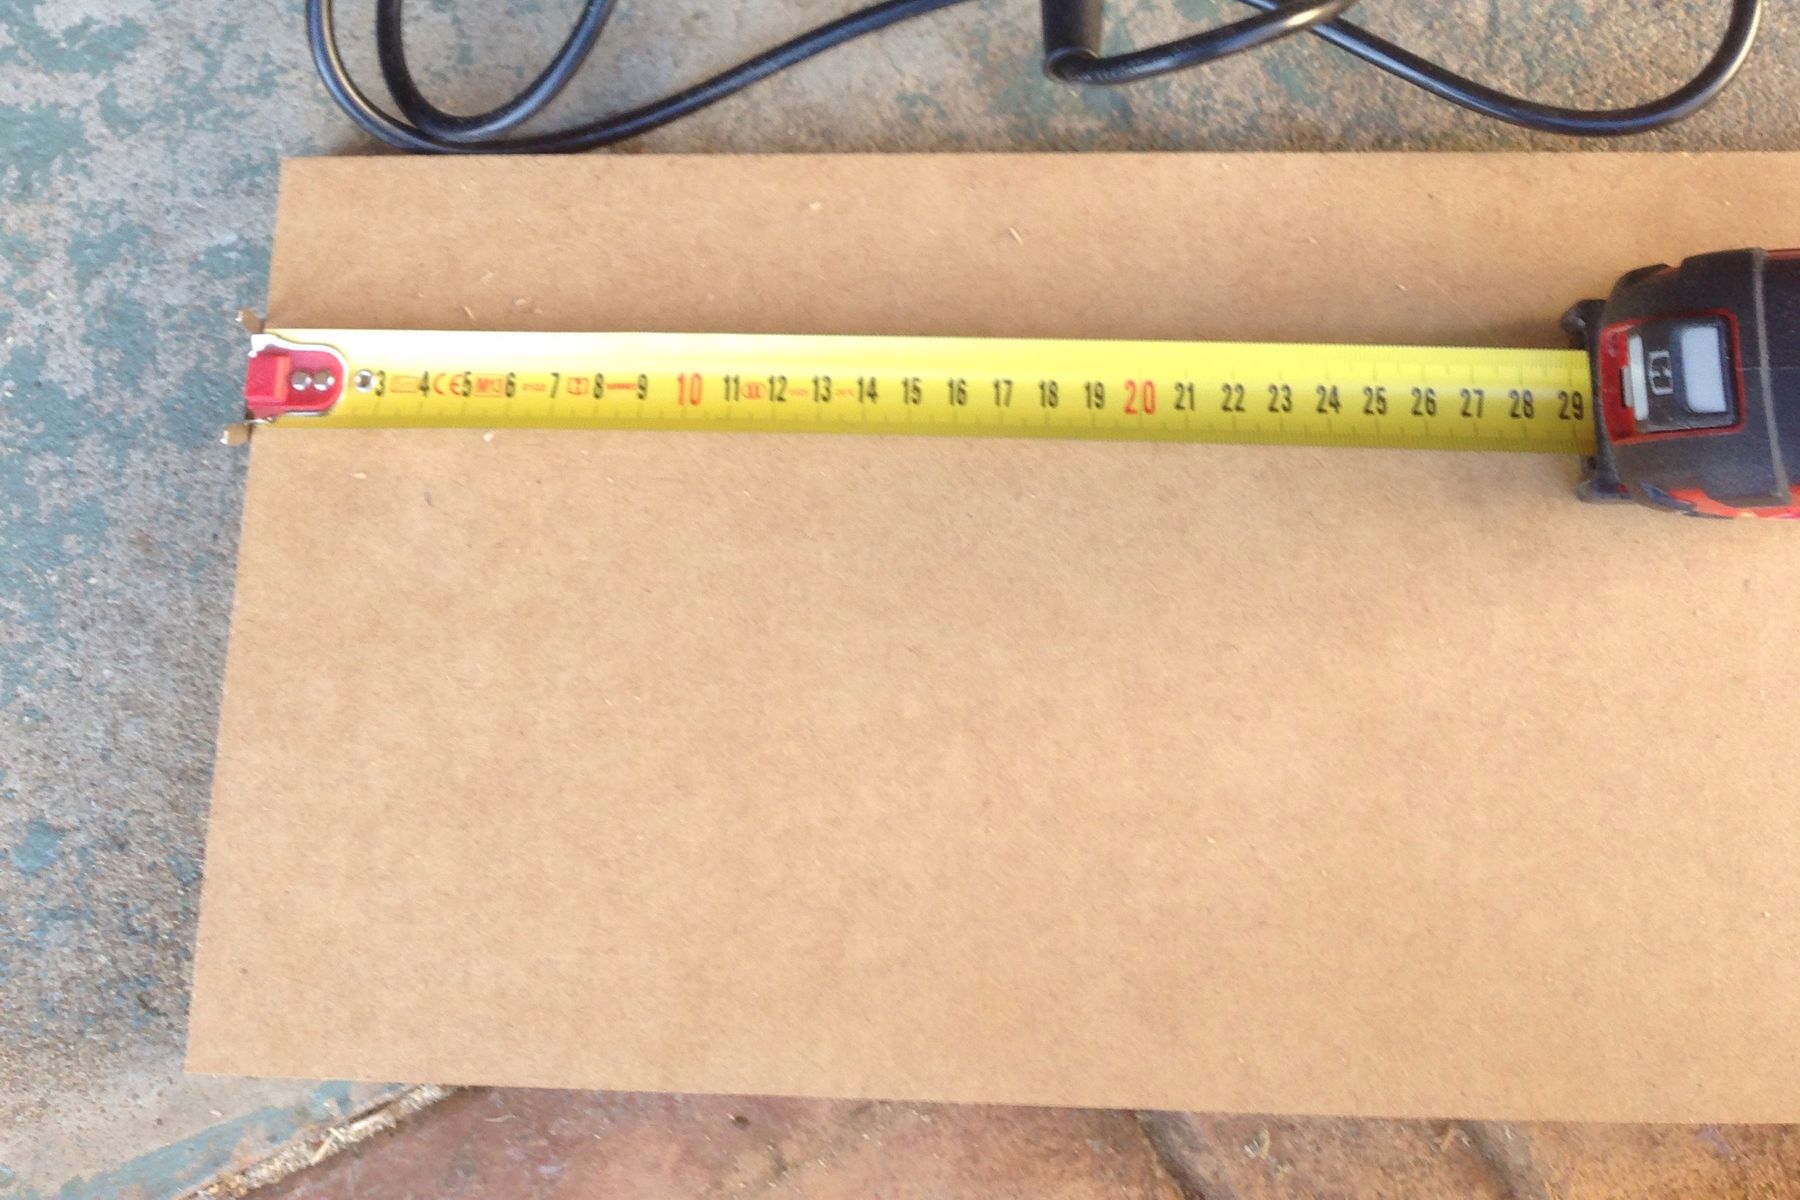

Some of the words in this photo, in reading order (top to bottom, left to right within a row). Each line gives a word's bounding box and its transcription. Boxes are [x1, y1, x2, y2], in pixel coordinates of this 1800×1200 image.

[374, 369, 386, 398] 3
[418, 370, 430, 398] 4
[461, 370, 473, 398] 5
[504, 371, 516, 399] 6
[549, 371, 561, 400] 7
[592, 372, 604, 401] 8
[636, 373, 649, 401] 9
[676, 372, 704, 407] 10
[723, 374, 740, 402] 11
[768, 374, 788, 403] 12
[812, 375, 832, 404] 13
[856, 376, 879, 405] 14
[901, 376, 923, 406] 15
[947, 377, 968, 407] 16
[992, 378, 1014, 408] 17
[1038, 379, 1059, 409] 18
[1084, 380, 1106, 410] 19
[1124, 379, 1156, 416] 20
[1173, 381, 1195, 412] 21
[1220, 382, 1246, 413] 22
[1267, 383, 1293, 414] 23
[1315, 384, 1342, 415] 24
[1362, 385, 1388, 417] 25
[1410, 386, 1438, 418] 26
[1460, 387, 1485, 418] 27
[1509, 389, 1535, 420] 28
[1559, 390, 1584, 421] 29
